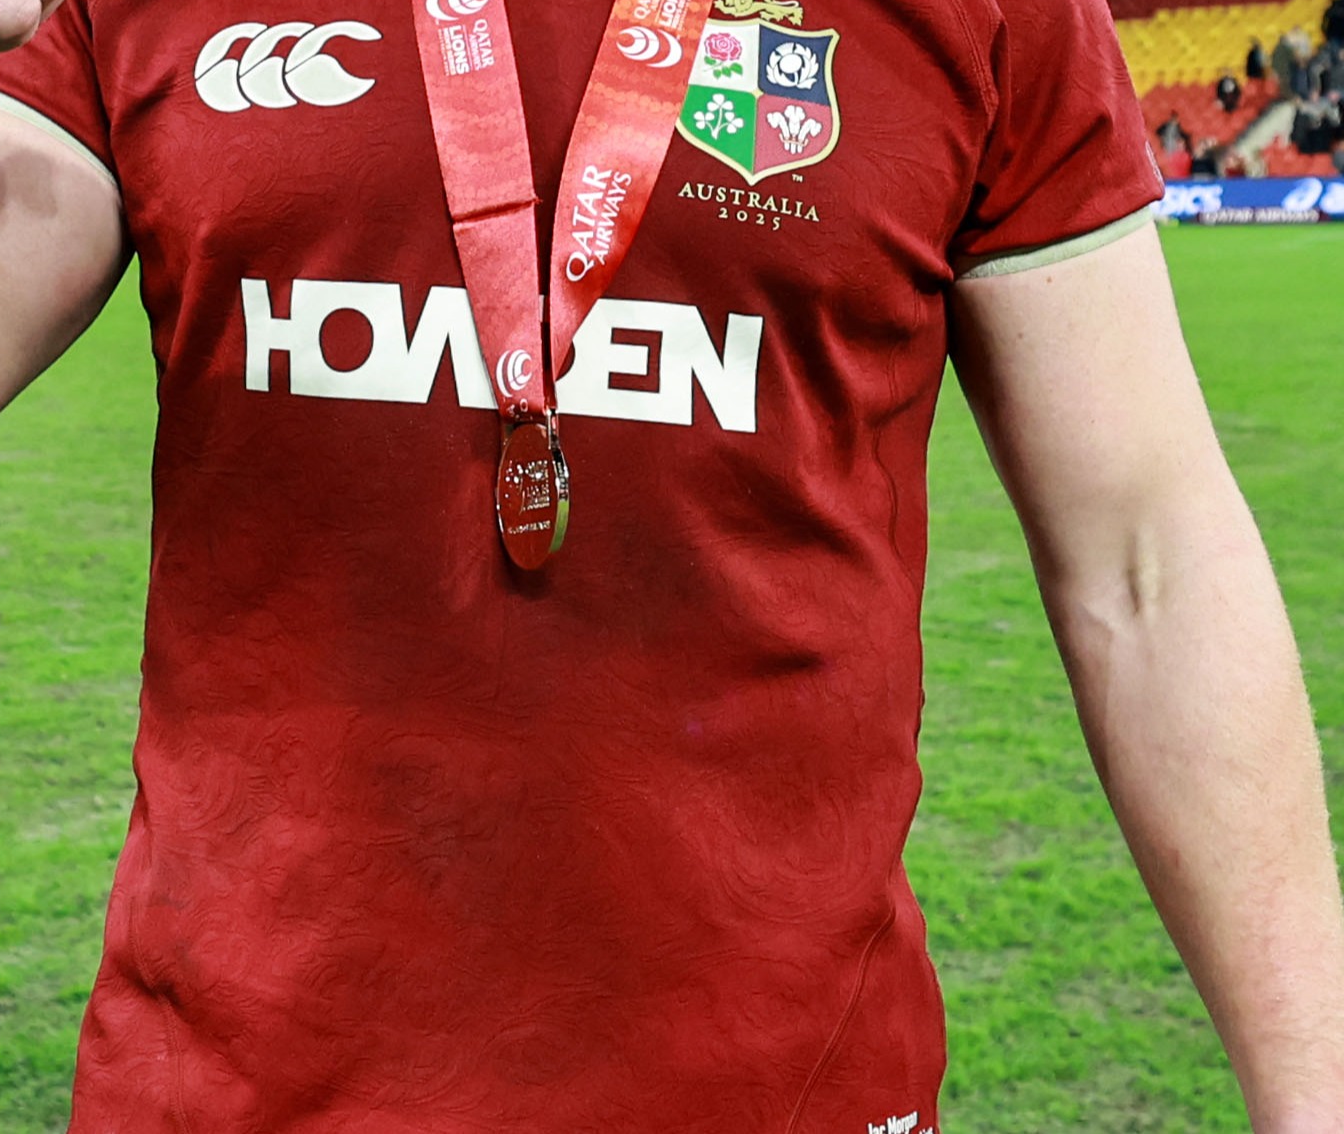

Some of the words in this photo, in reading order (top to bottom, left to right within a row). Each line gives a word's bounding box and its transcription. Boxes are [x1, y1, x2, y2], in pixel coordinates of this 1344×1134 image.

[450, 25, 471, 75] LIONS
[473, 19, 495, 68] QATAR
[566, 165, 613, 282] QATAR
[594, 171, 632, 265] AIRWAYS
[678, 182, 820, 222] AUSTRALIA
[718, 207, 781, 231] 2025
